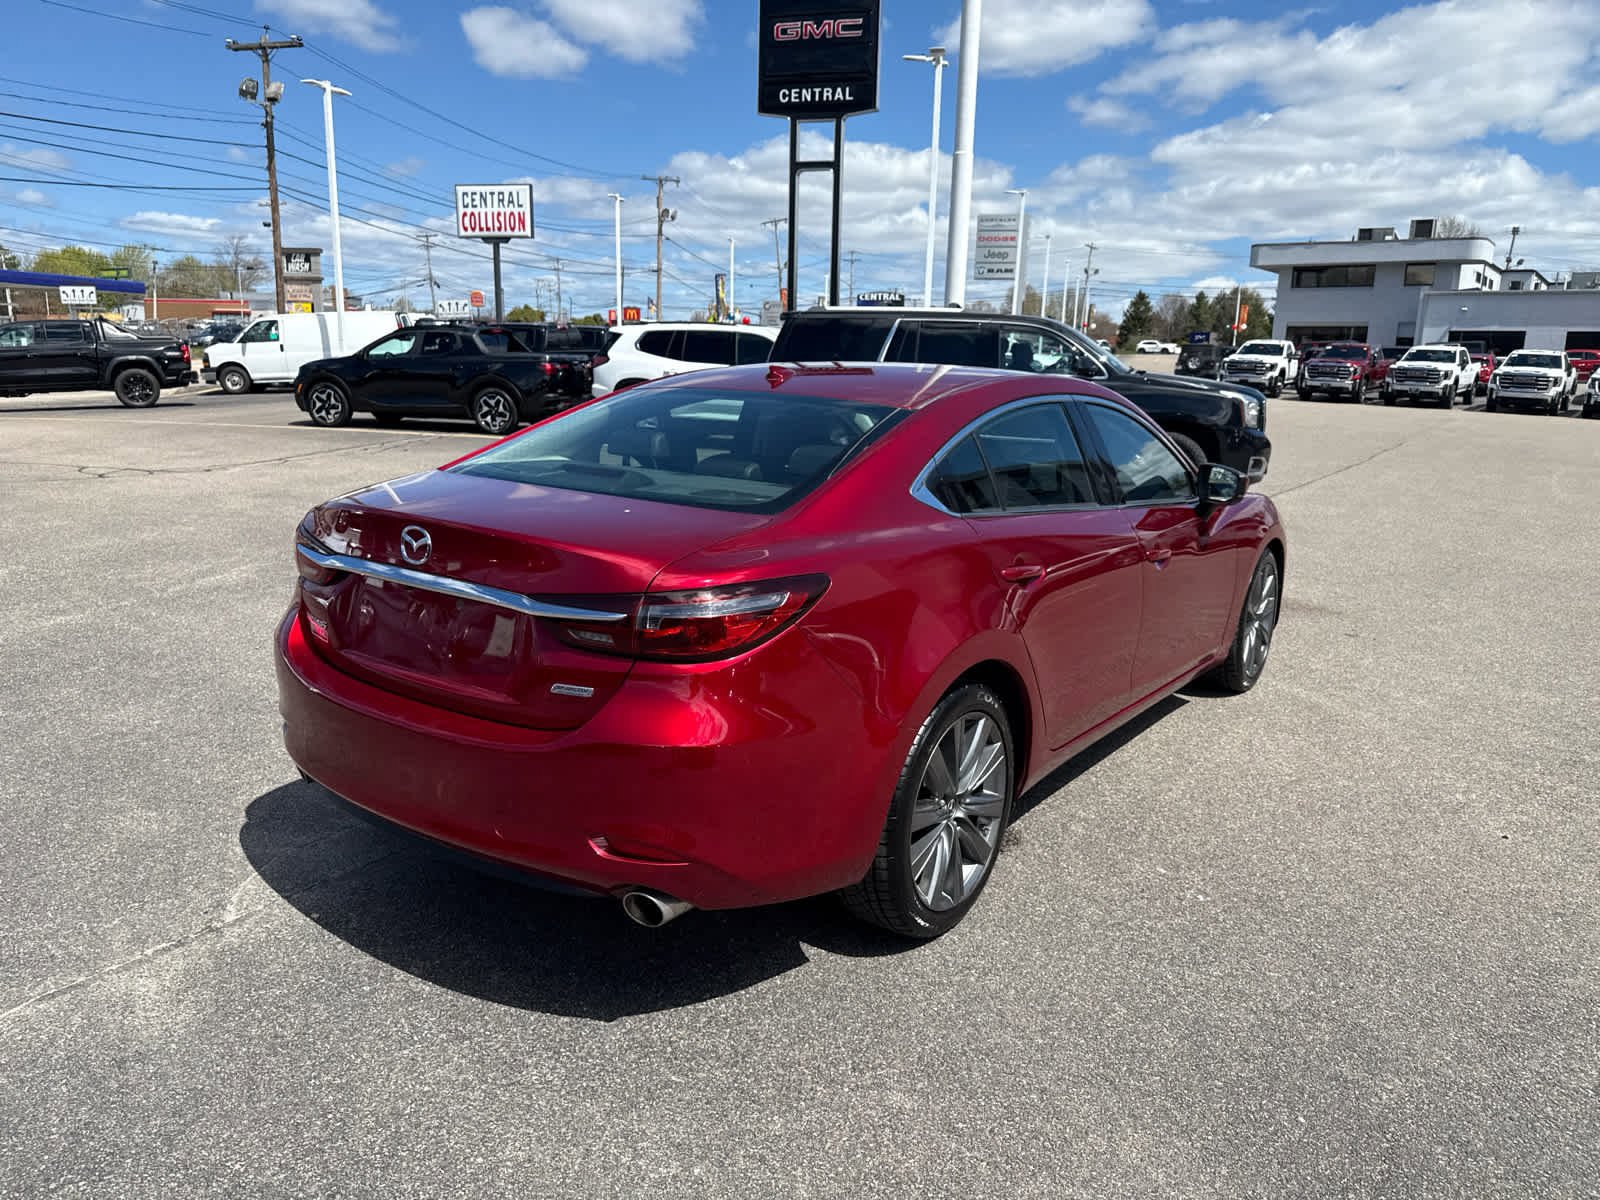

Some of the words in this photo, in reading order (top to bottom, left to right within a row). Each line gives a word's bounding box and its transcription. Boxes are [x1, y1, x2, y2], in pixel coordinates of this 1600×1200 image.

[773, 18, 864, 41] GMC
[779, 86, 855, 103] CENTRAL
[462, 191, 524, 209] CENTRAL
[461, 211, 527, 233] COLLISION
[983, 249, 1009, 261] Jeep
[287, 262, 310, 273] WASH
[858, 292, 902, 301] CENTRAL
